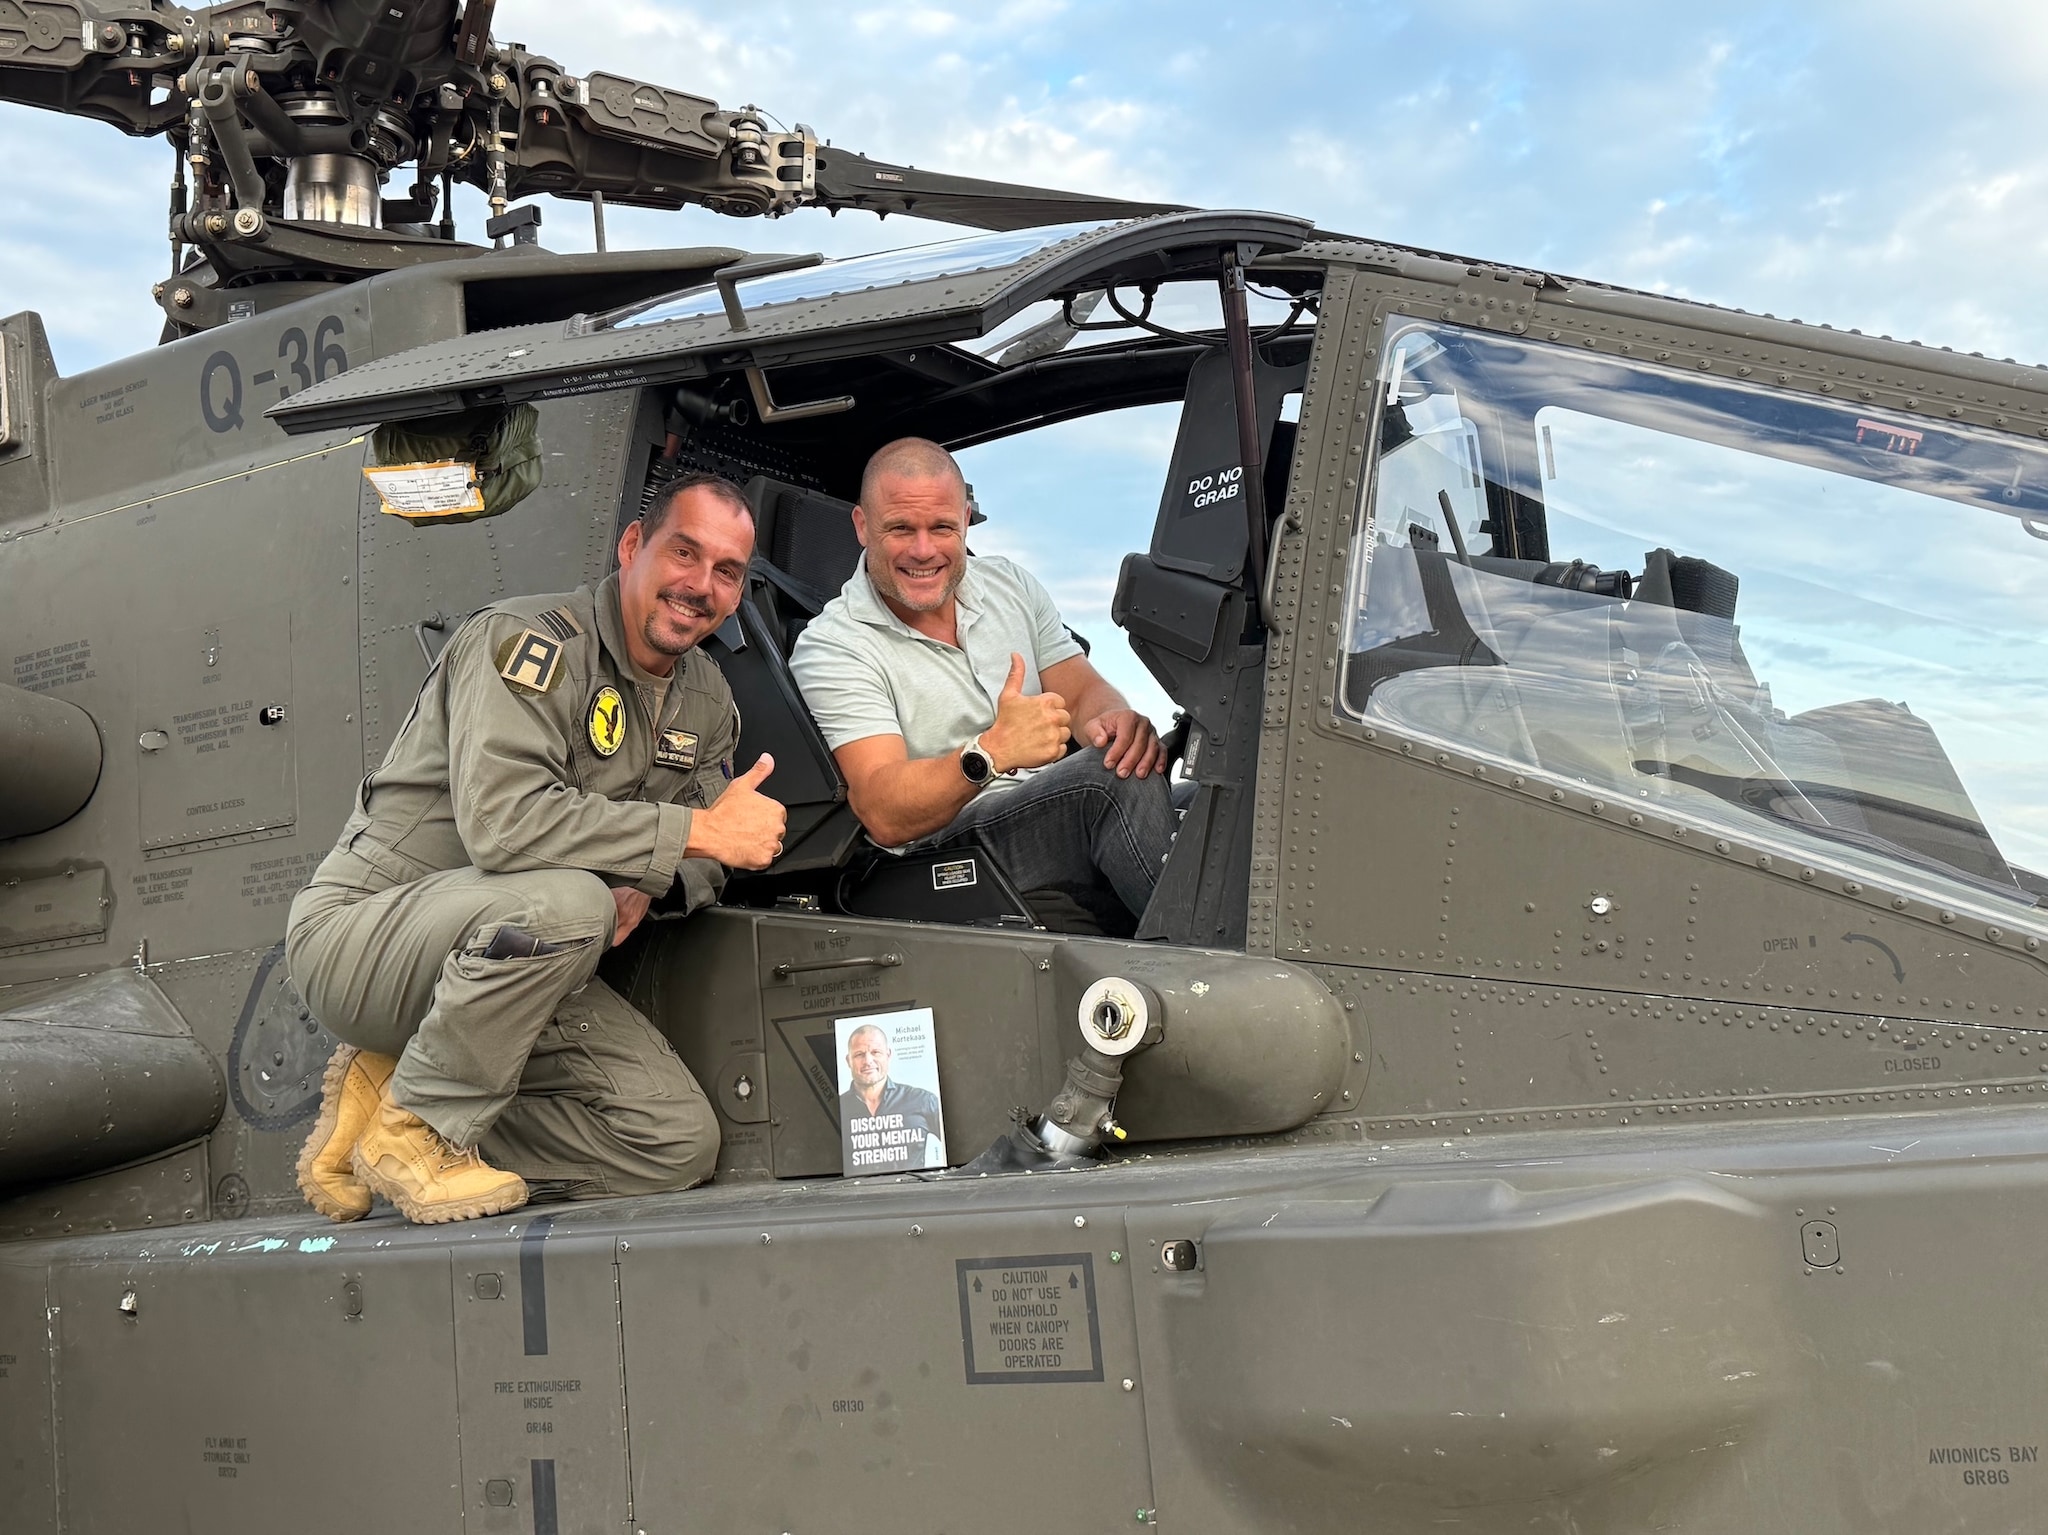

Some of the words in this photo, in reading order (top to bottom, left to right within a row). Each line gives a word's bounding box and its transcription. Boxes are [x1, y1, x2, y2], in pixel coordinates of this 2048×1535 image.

[201, 315, 348, 433] Q-36
[115, 405, 135, 418] GLASS
[1188, 476, 1213, 494] DO
[1218, 466, 1243, 485] NO
[1194, 483, 1239, 508] GRAB
[1367, 516, 1376, 532] NO
[219, 705, 229, 715] OIL
[231, 699, 254, 713] FILLER
[177, 723, 197, 735] SPOUT
[199, 718, 219, 730] INSIDE
[223, 712, 249, 726] SERVICE
[229, 725, 245, 735] WITH
[218, 740, 231, 750] AGL
[186, 803, 219, 816] CONTROLS
[220, 798, 246, 810] ACCESS
[250, 858, 284, 872] PRESSURE
[286, 855, 304, 866] FUEL
[133, 873, 147, 885] MAIN
[149, 867, 193, 882] TRANSMISSION
[242, 874, 261, 885] TOTAL
[263, 869, 292, 882] CAPACITY
[294, 866, 307, 877] 375
[137, 885, 147, 895] OIL
[149, 882, 169, 893] LEVEL
[171, 879, 189, 890] SIGHT
[241, 887, 254, 897] USE
[142, 894, 163, 906] GAUGE
[164, 891, 184, 902] INSIDE
[264, 892, 297, 905] MIL-DTL-
[814, 940, 826, 951] NO
[829, 936, 851, 949] STEP
[1763, 937, 1799, 953] OPEN
[800, 980, 847, 997] EXPLOSIVE
[849, 976, 881, 990] DEVICE
[803, 996, 836, 1010] CANOPY
[840, 990, 881, 1005] JETTISON
[895, 1025, 921, 1035] Michael
[892, 1034, 926, 1044] Kortekaas
[1884, 1056, 1941, 1073] CLOSED
[810, 1064, 835, 1103] DANGER
[850, 1113, 904, 1133] DISCOVER
[850, 1131, 880, 1149] YOUR
[881, 1127, 925, 1146] MENTAL
[852, 1145, 908, 1166] STRENGTH
[1002, 1270, 1049, 1285] CAUTION
[992, 1288, 1007, 1302] DO
[1012, 1287, 1033, 1301] NOT
[1038, 1286, 1062, 1300] USE
[998, 1303, 1058, 1319] HANDHOLD
[989, 1321, 1021, 1336] WHEN
[1026, 1319, 1070, 1334] CANOPY
[999, 1338, 1037, 1352] DOORS
[1041, 1337, 1064, 1350] ARE
[1004, 1354, 1062, 1368] OPERATED
[494, 1381, 515, 1394] FIRE
[517, 1379, 582, 1393] EXTINGUISHER
[523, 1396, 553, 1409] INSIDE
[832, 1400, 864, 1413] GR130
[1928, 1447, 2002, 1465] AVIONICS
[2009, 1446, 2039, 1463] BAY
